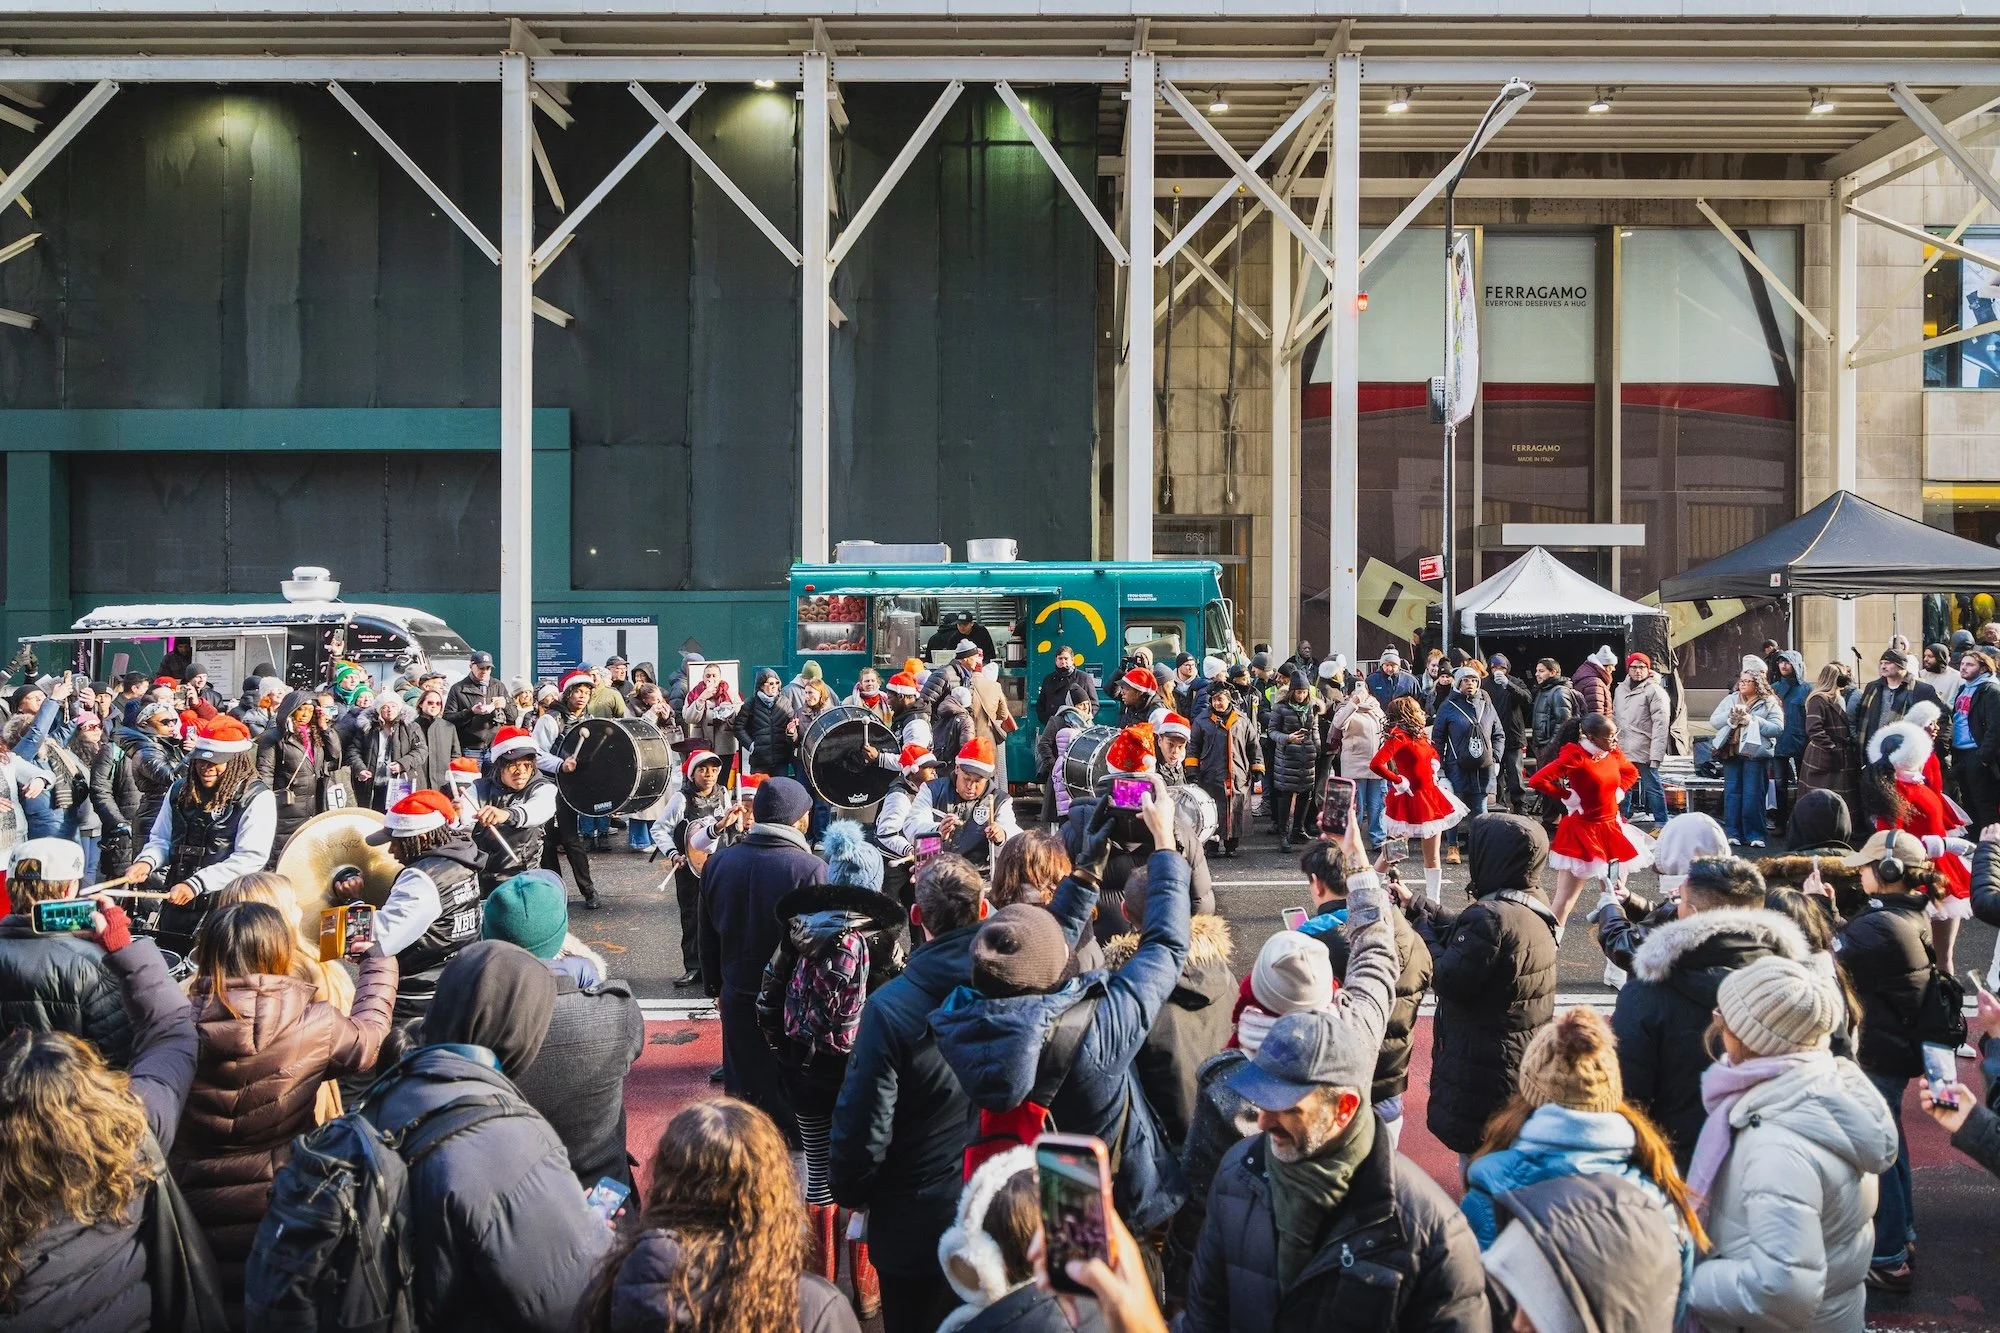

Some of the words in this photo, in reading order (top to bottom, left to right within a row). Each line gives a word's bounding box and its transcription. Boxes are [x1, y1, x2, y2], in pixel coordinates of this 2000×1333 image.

[1485, 286, 1587, 299] FERRAGAMO
[1186, 532, 1205, 542] 663
[538, 616, 559, 624] Work
[560, 616, 568, 624] in
[570, 616, 605, 625] Progress:
[606, 616, 650, 624] Commercial
[452, 914, 476, 932] NBU
